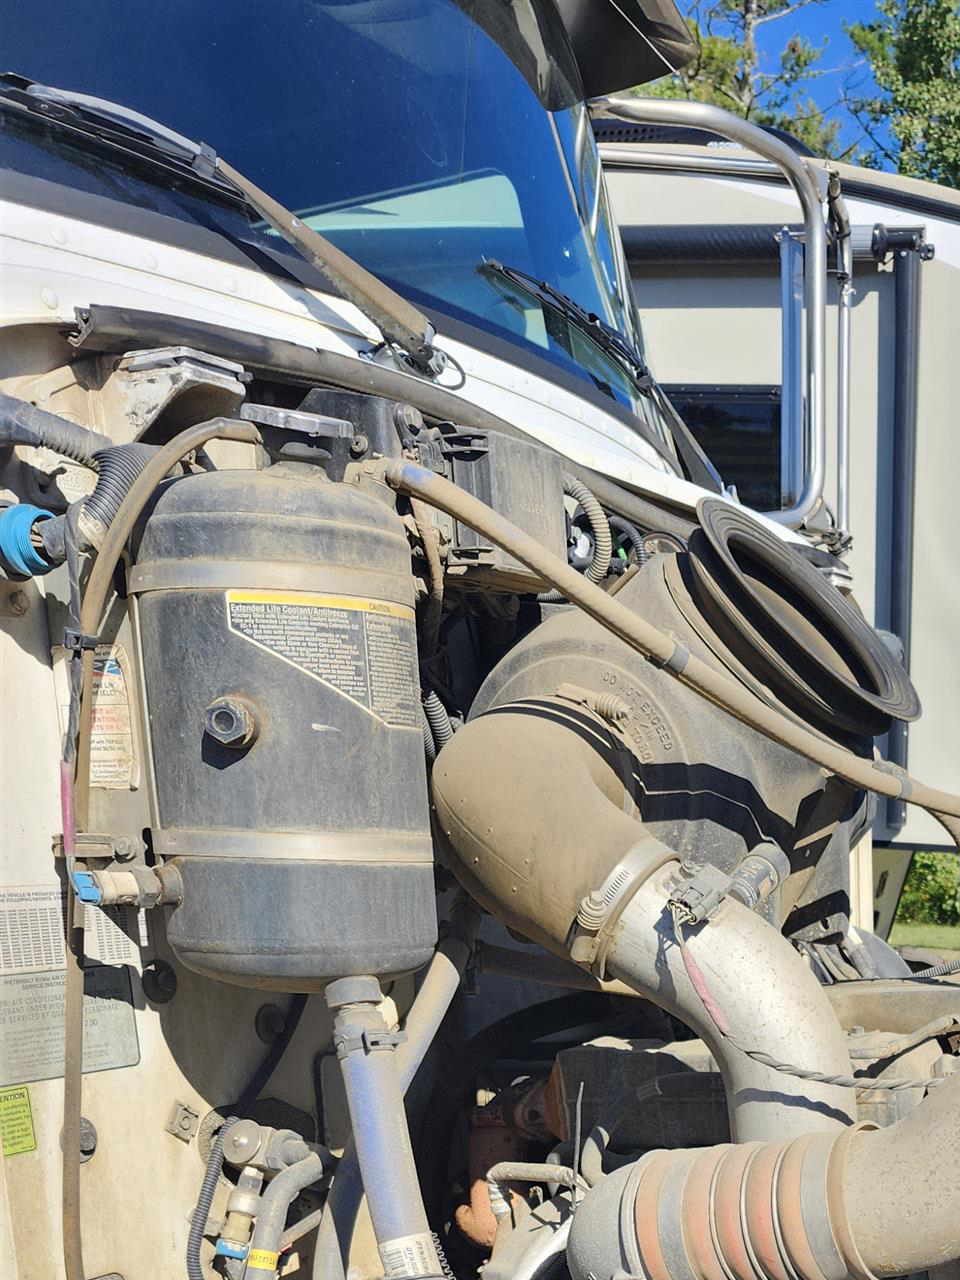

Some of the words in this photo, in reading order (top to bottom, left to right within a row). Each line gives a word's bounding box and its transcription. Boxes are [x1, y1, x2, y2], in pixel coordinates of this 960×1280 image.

[231, 603, 265, 613] Extended
[267, 604, 281, 614] Life
[640, 701, 674, 751] EXCEED
